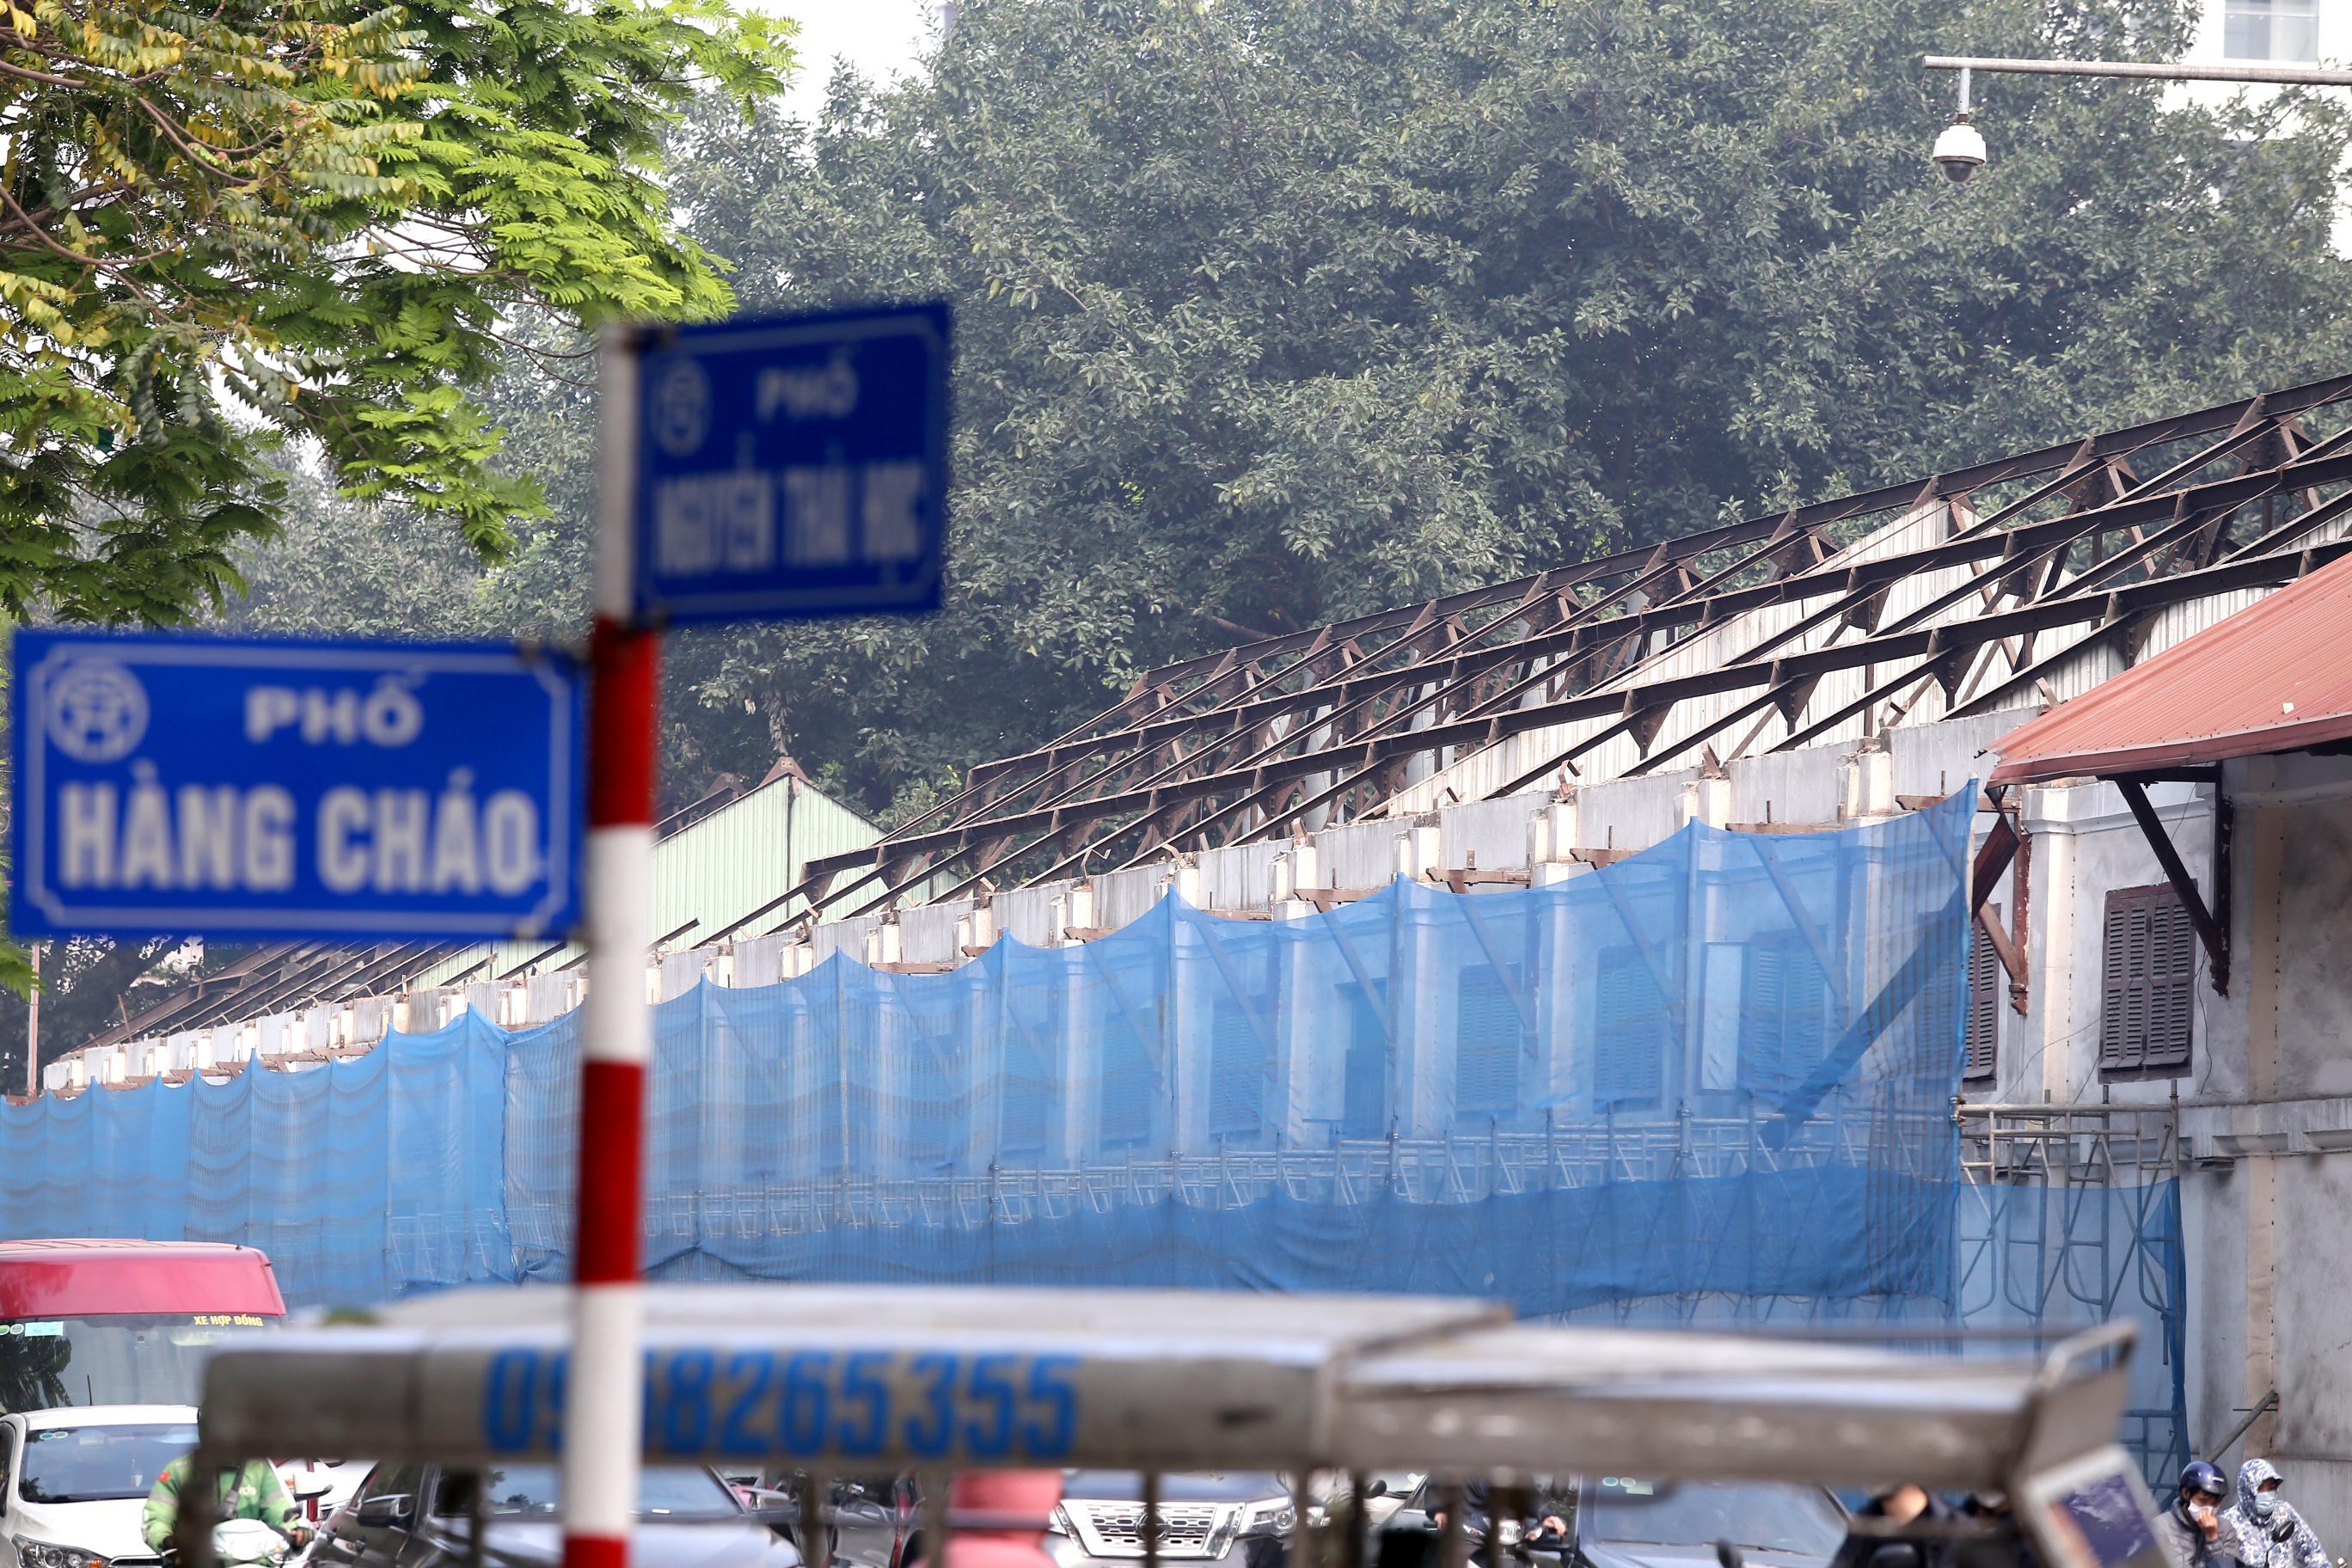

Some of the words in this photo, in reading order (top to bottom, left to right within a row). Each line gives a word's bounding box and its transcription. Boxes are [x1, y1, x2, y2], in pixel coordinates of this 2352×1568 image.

[244, 665, 426, 748] PHỐ
[58, 758, 297, 891] HÀNG
[315, 764, 540, 897] CHÁO
[193, 1315, 209, 1326] XE
[210, 1314, 232, 1327] HỢP
[484, 1345, 1082, 1455] 08265355
